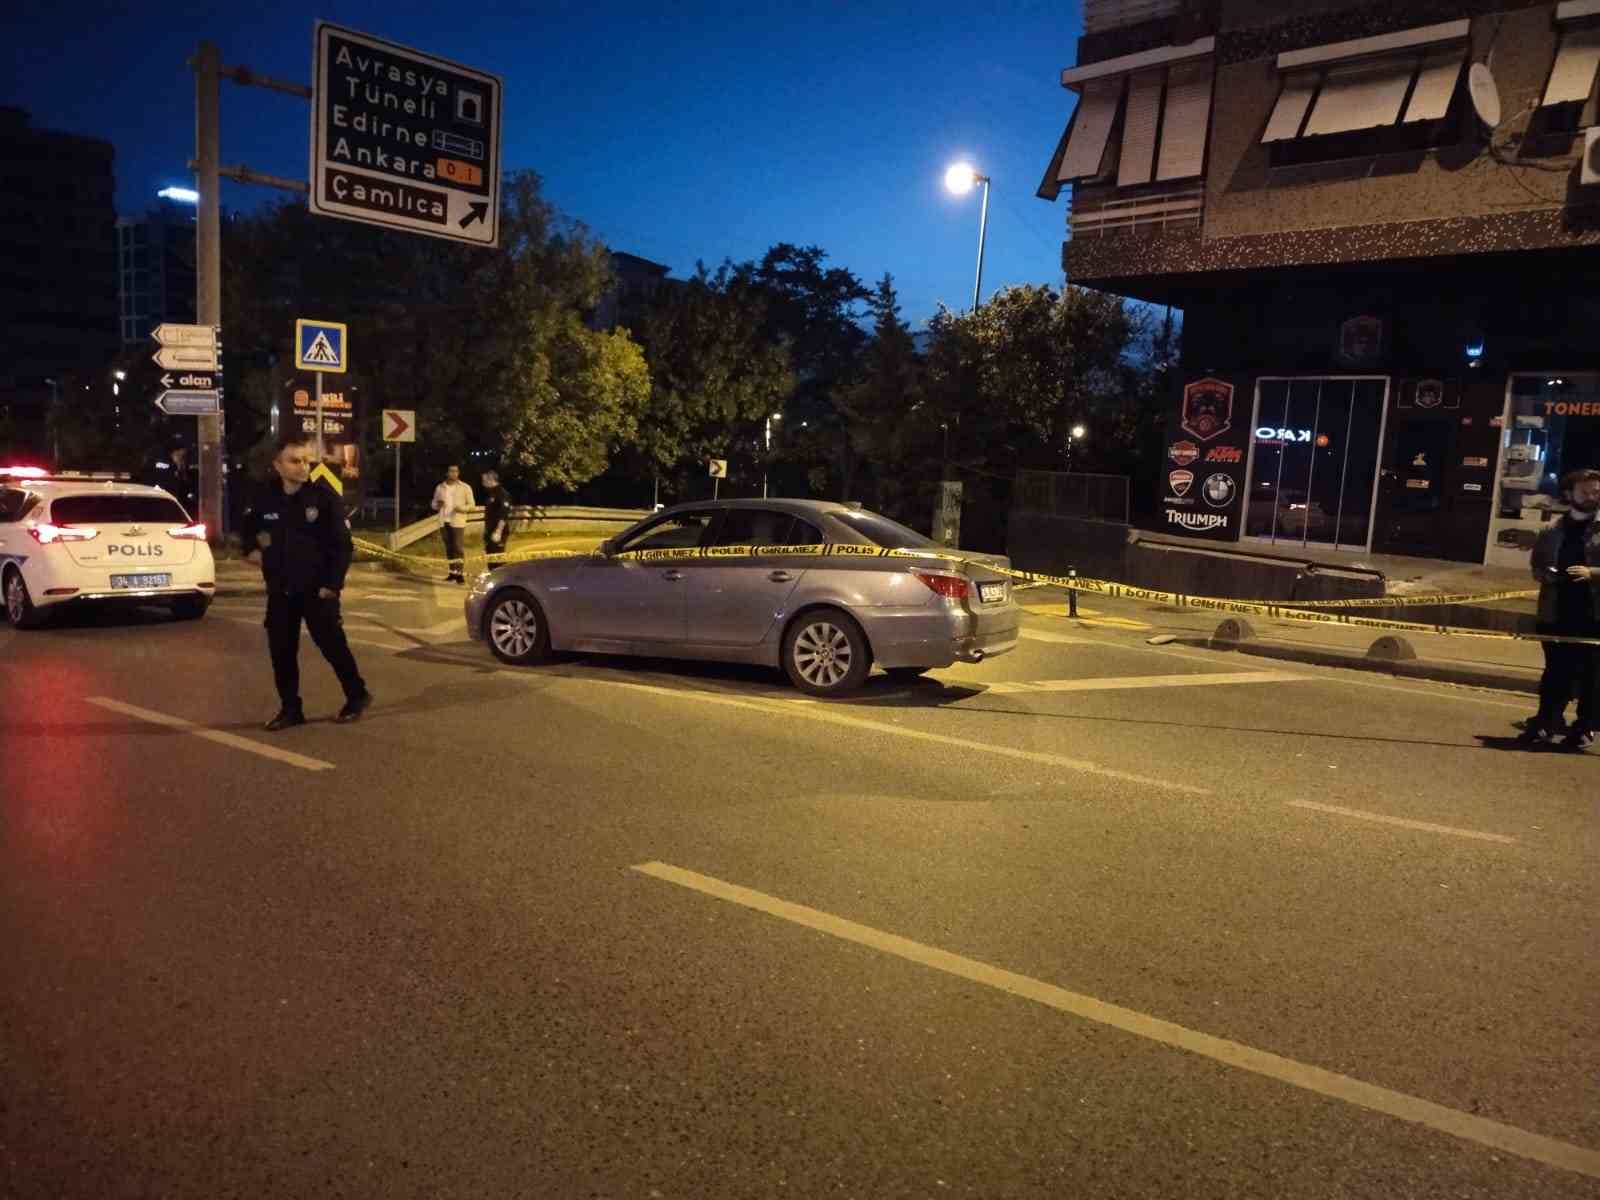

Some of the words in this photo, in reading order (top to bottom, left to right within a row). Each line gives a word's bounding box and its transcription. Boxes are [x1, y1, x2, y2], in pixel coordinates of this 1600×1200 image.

[336, 46, 448, 96] Avrasya
[333, 104, 427, 147] Edirne
[333, 137, 436, 179] Ankara
[332, 175, 443, 217] Çamlıca
[179, 373, 212, 386] alan
[1165, 509, 1228, 528] TRIUMPH
